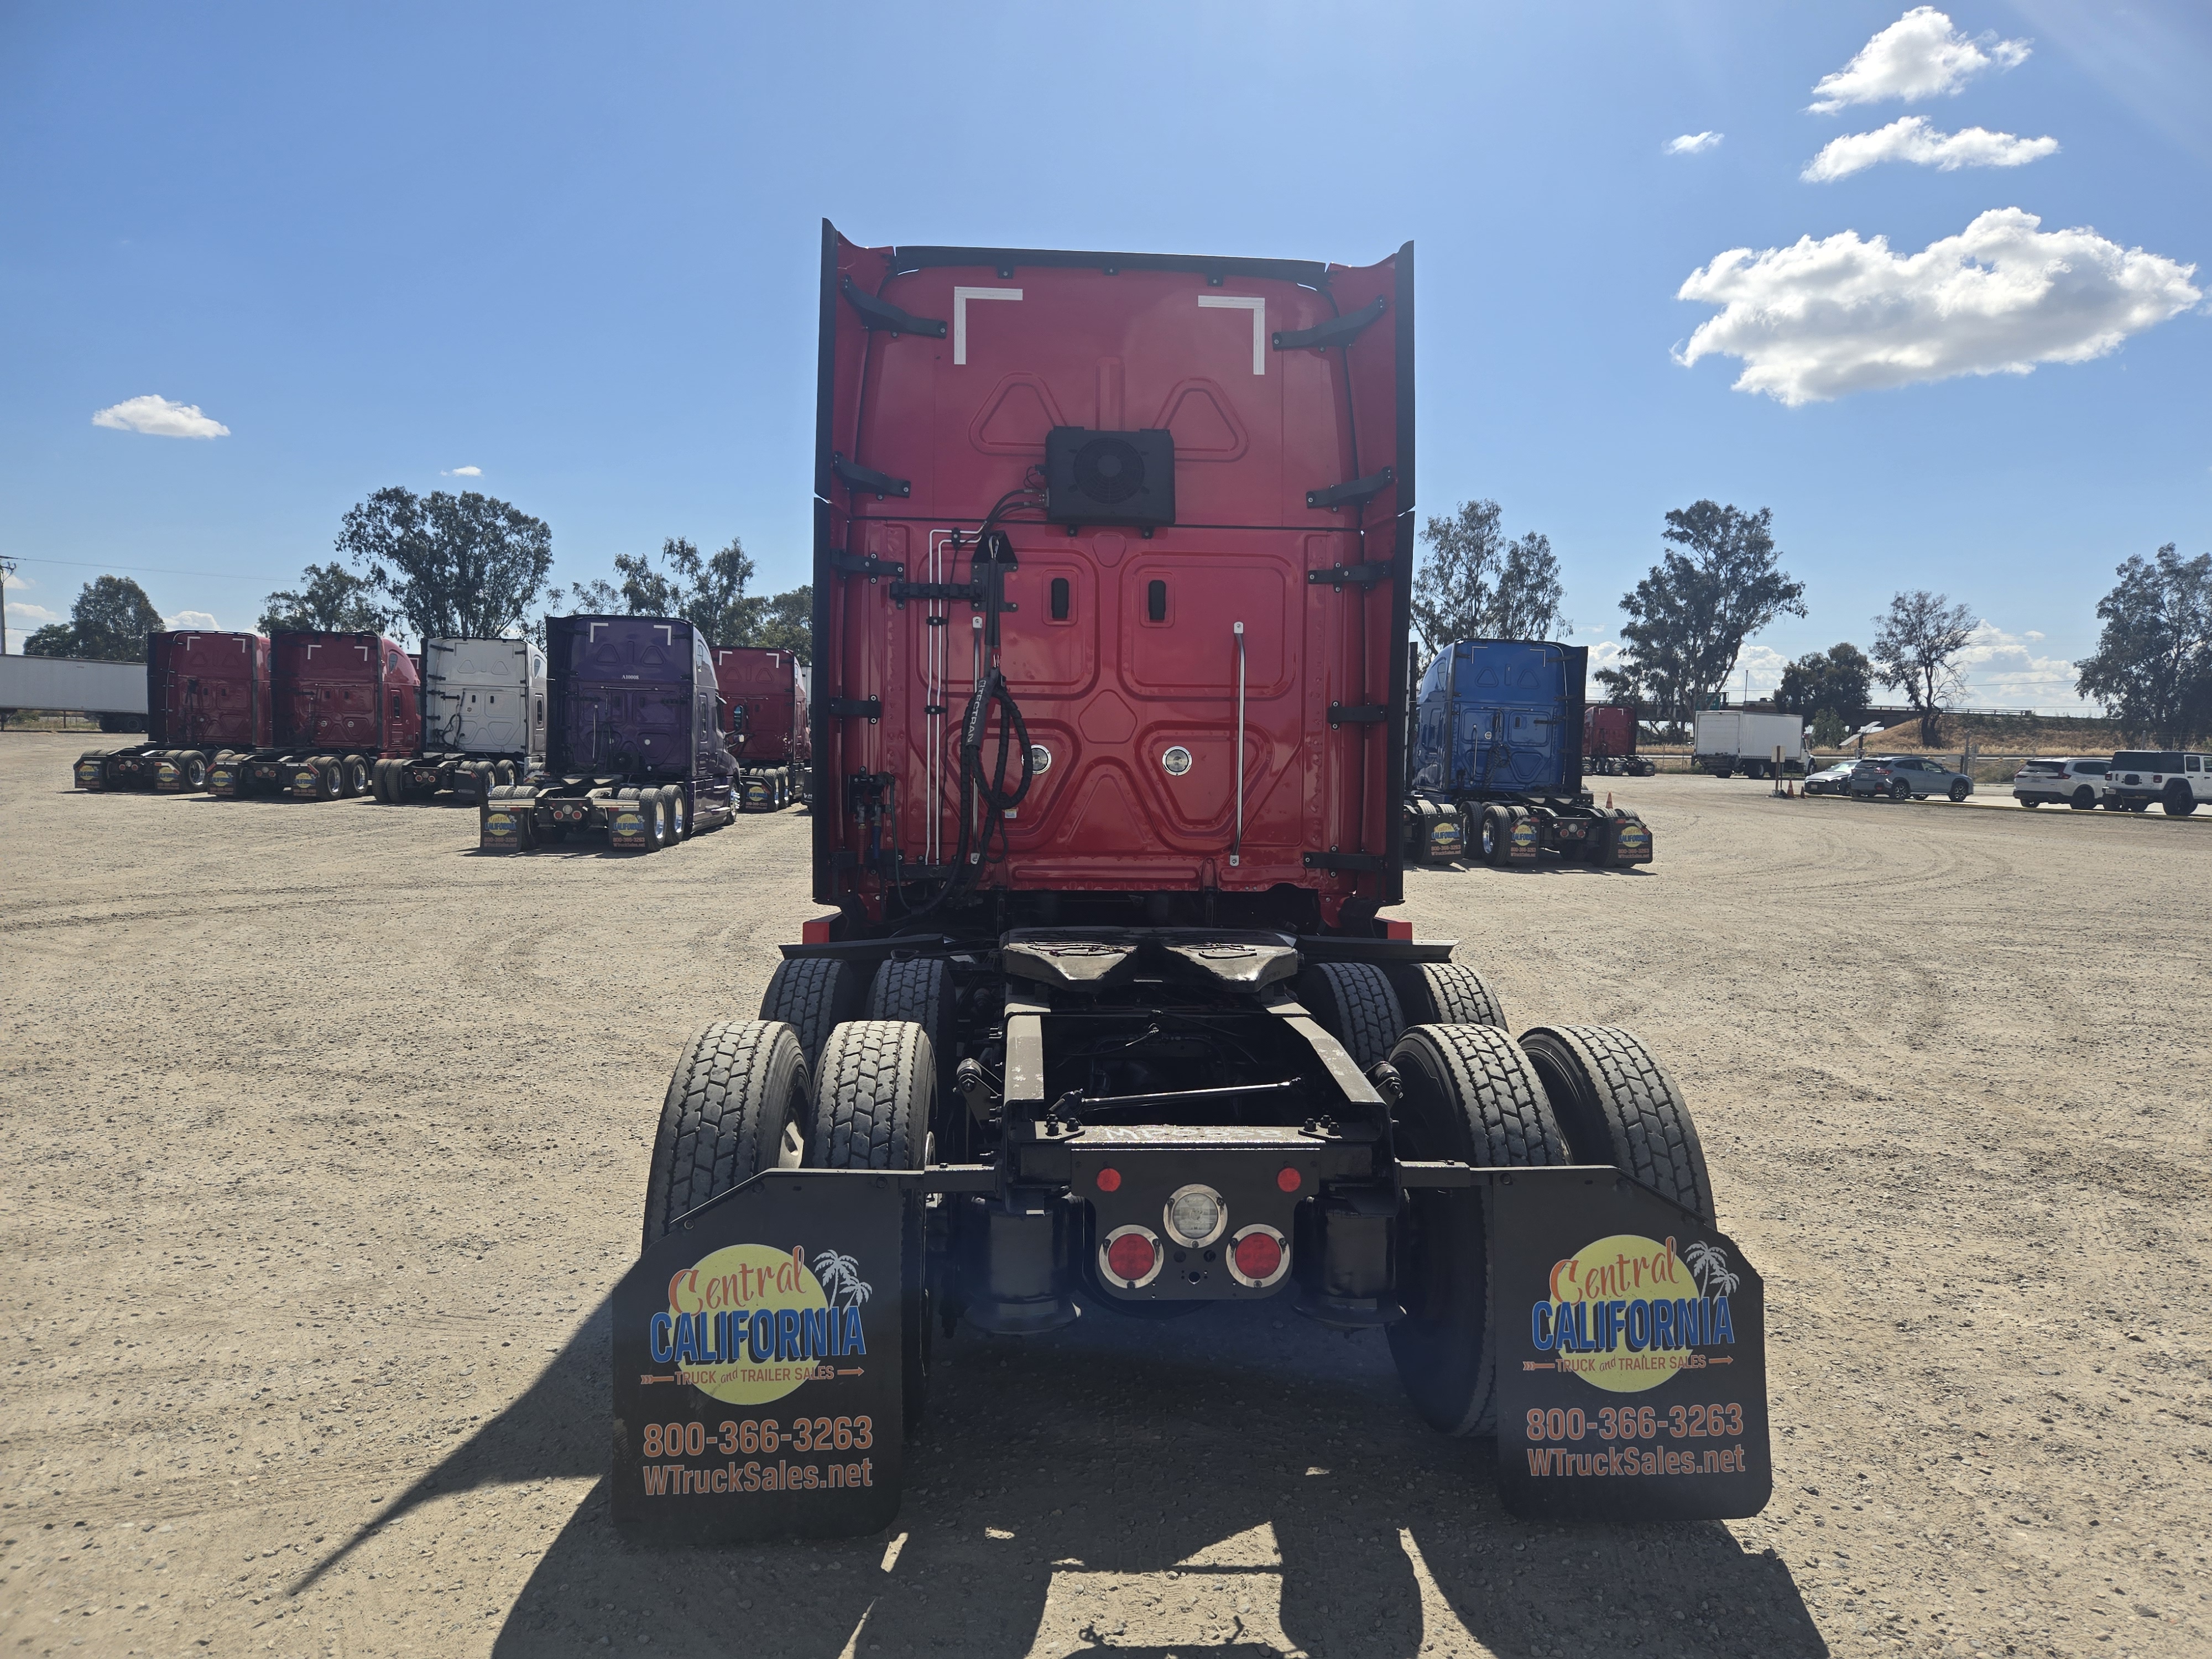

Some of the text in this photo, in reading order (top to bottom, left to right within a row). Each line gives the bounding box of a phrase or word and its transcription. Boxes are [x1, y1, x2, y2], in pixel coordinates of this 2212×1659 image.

[967, 688, 984, 743] TECTRAN
[668, 1245, 806, 1317] Central
[1549, 1235, 1679, 1306] Central
[650, 1305, 867, 1364] CALIFORNIA
[1531, 1296, 1735, 1353] CALIFORNIA
[674, 1365, 835, 1385] TRUCK and TRAILER SALES
[1555, 1354, 1707, 1373] TRUCK and TRAILER SALES
[643, 1415, 873, 1458] 800-366-3263
[1526, 1402, 1744, 1441] 800-366-3263
[643, 1457, 873, 1496] WTruckSales.net
[1527, 1443, 1746, 1477] WTruckSales.net
